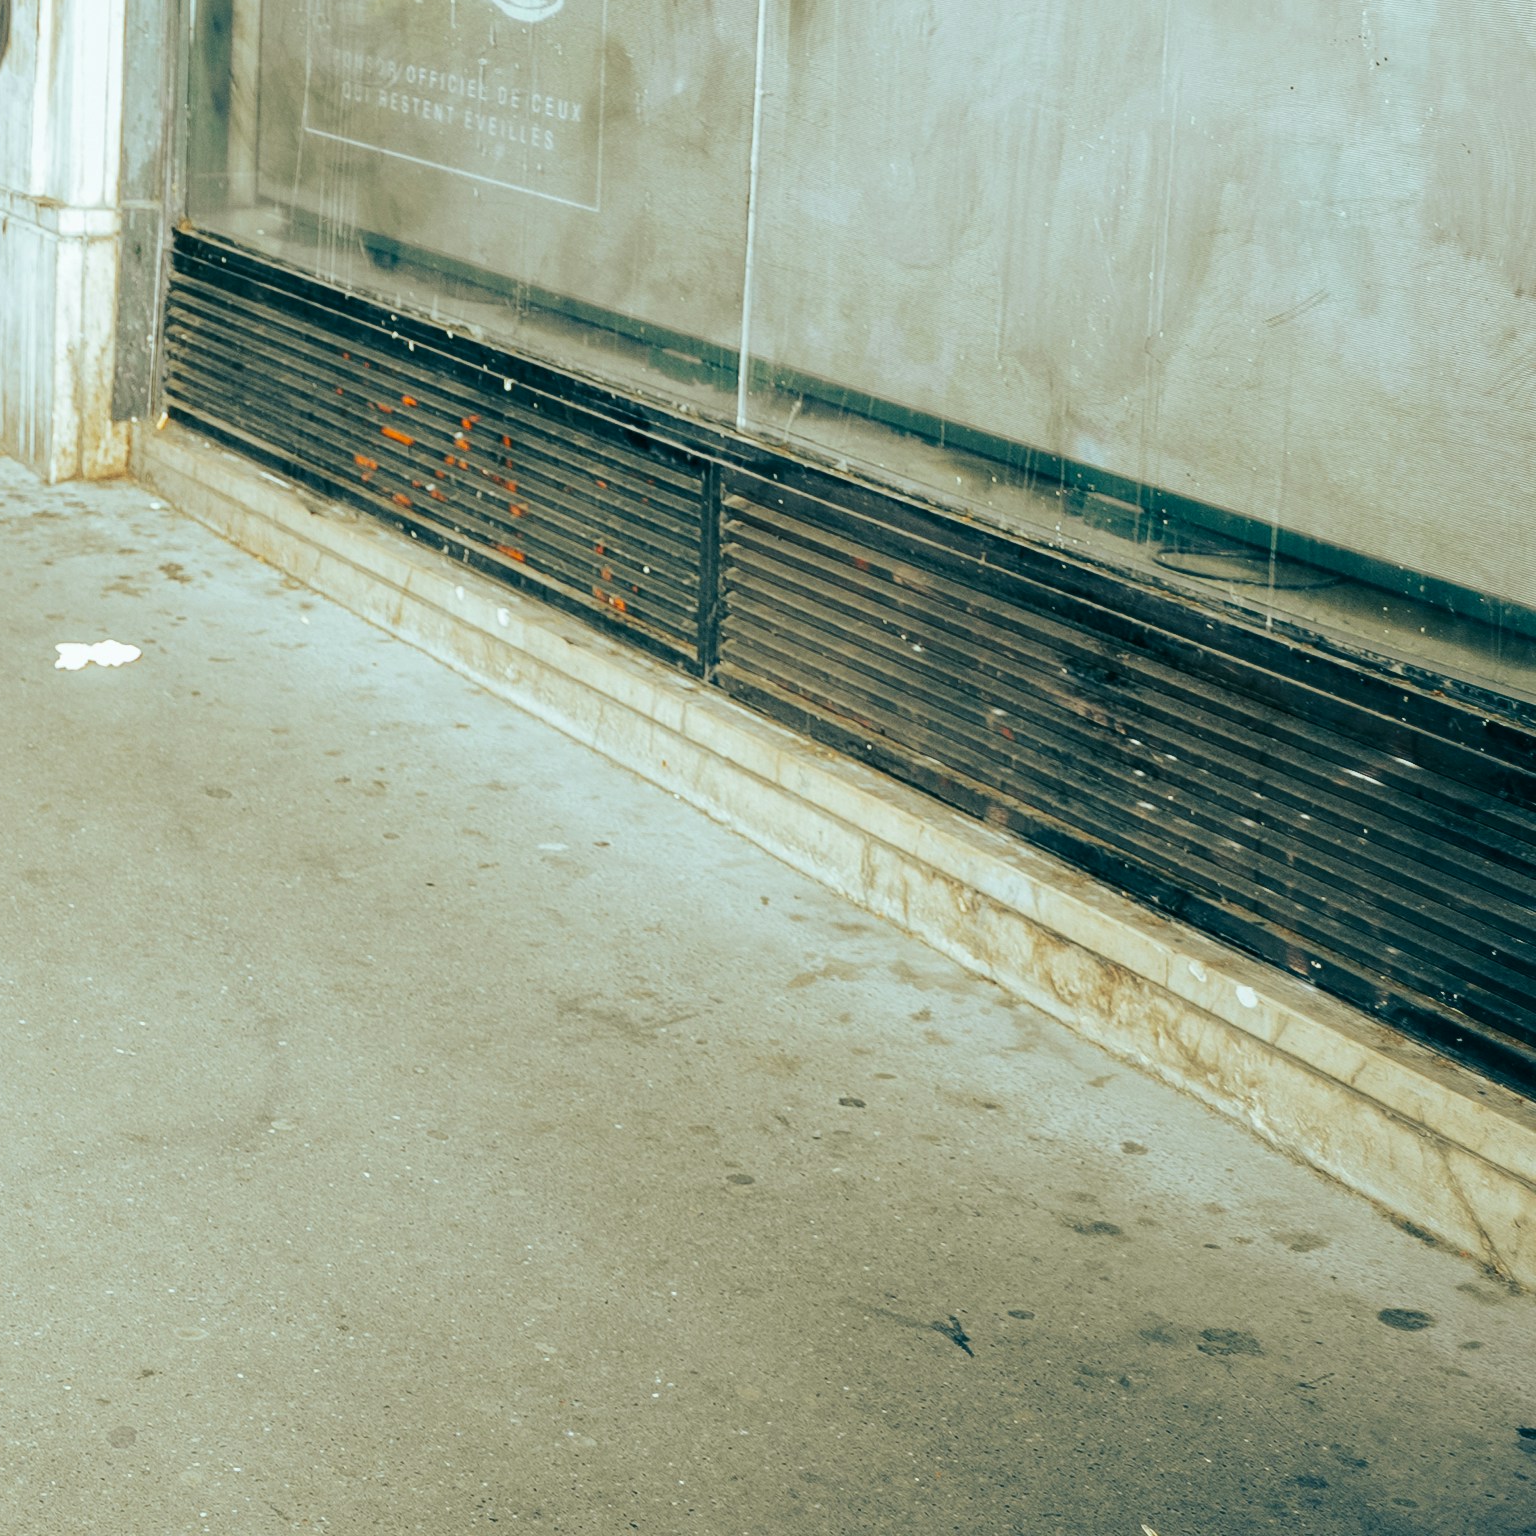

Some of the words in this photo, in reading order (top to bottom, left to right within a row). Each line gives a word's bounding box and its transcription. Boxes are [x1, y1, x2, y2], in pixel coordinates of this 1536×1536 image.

[341, 81, 370, 102] QUI
[378, 90, 455, 124] RESTENT
[406, 65, 488, 102] OFFICIEL
[498, 86, 521, 109] DE
[532, 94, 582, 122] CEUX
